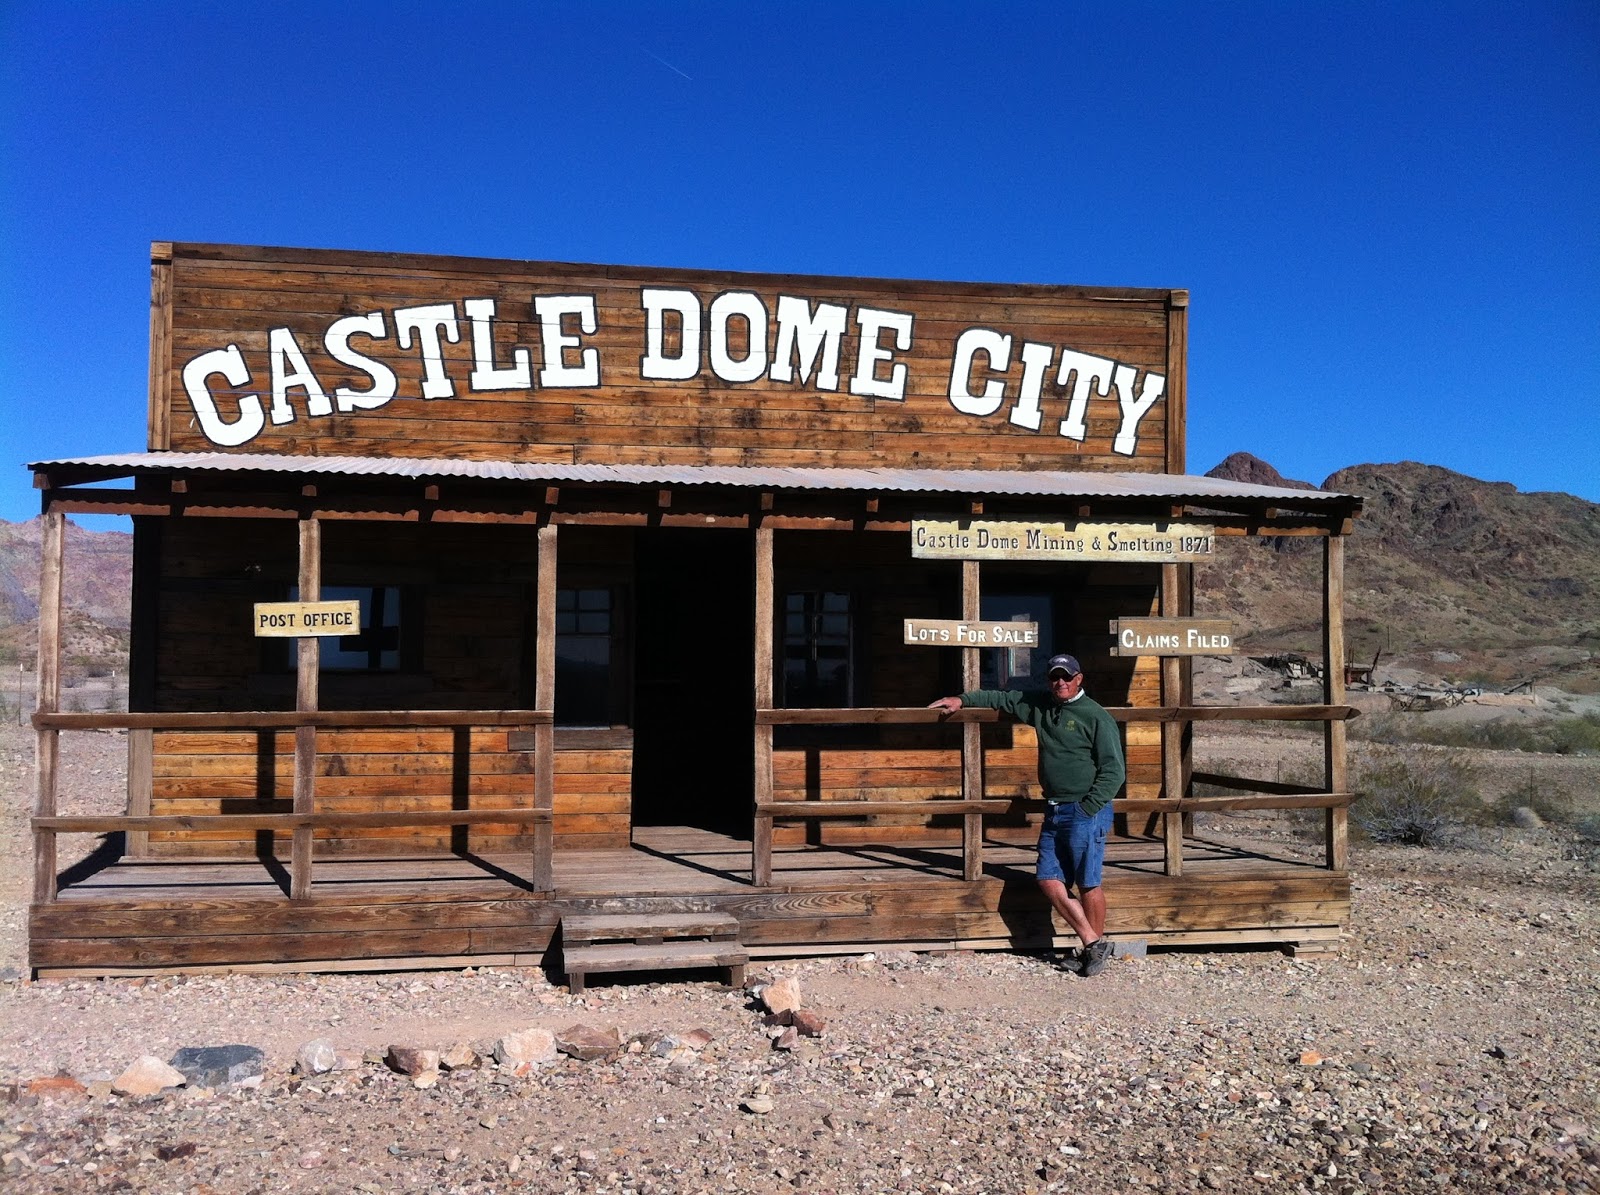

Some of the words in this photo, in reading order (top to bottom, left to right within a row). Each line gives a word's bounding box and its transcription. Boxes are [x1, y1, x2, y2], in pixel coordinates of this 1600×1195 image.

[181, 294, 601, 447] CASTLE
[639, 286, 915, 402] DOME
[949, 326, 1166, 457] CITY
[916, 529, 970, 550] Castle
[976, 528, 1019, 550] Dome
[1025, 529, 1085, 553] Mining
[1091, 536, 1103, 551] &
[1107, 531, 1173, 554] Smelting
[1179, 536, 1212, 554] 1871
[260, 614, 295, 627] POST
[303, 612, 353, 627] OFFICE
[908, 623, 950, 642] LOTS
[957, 625, 987, 643] FOR
[992, 626, 1034, 644] SALE
[1121, 629, 1180, 648] CLAIMS
[1187, 629, 1230, 648] FILED
